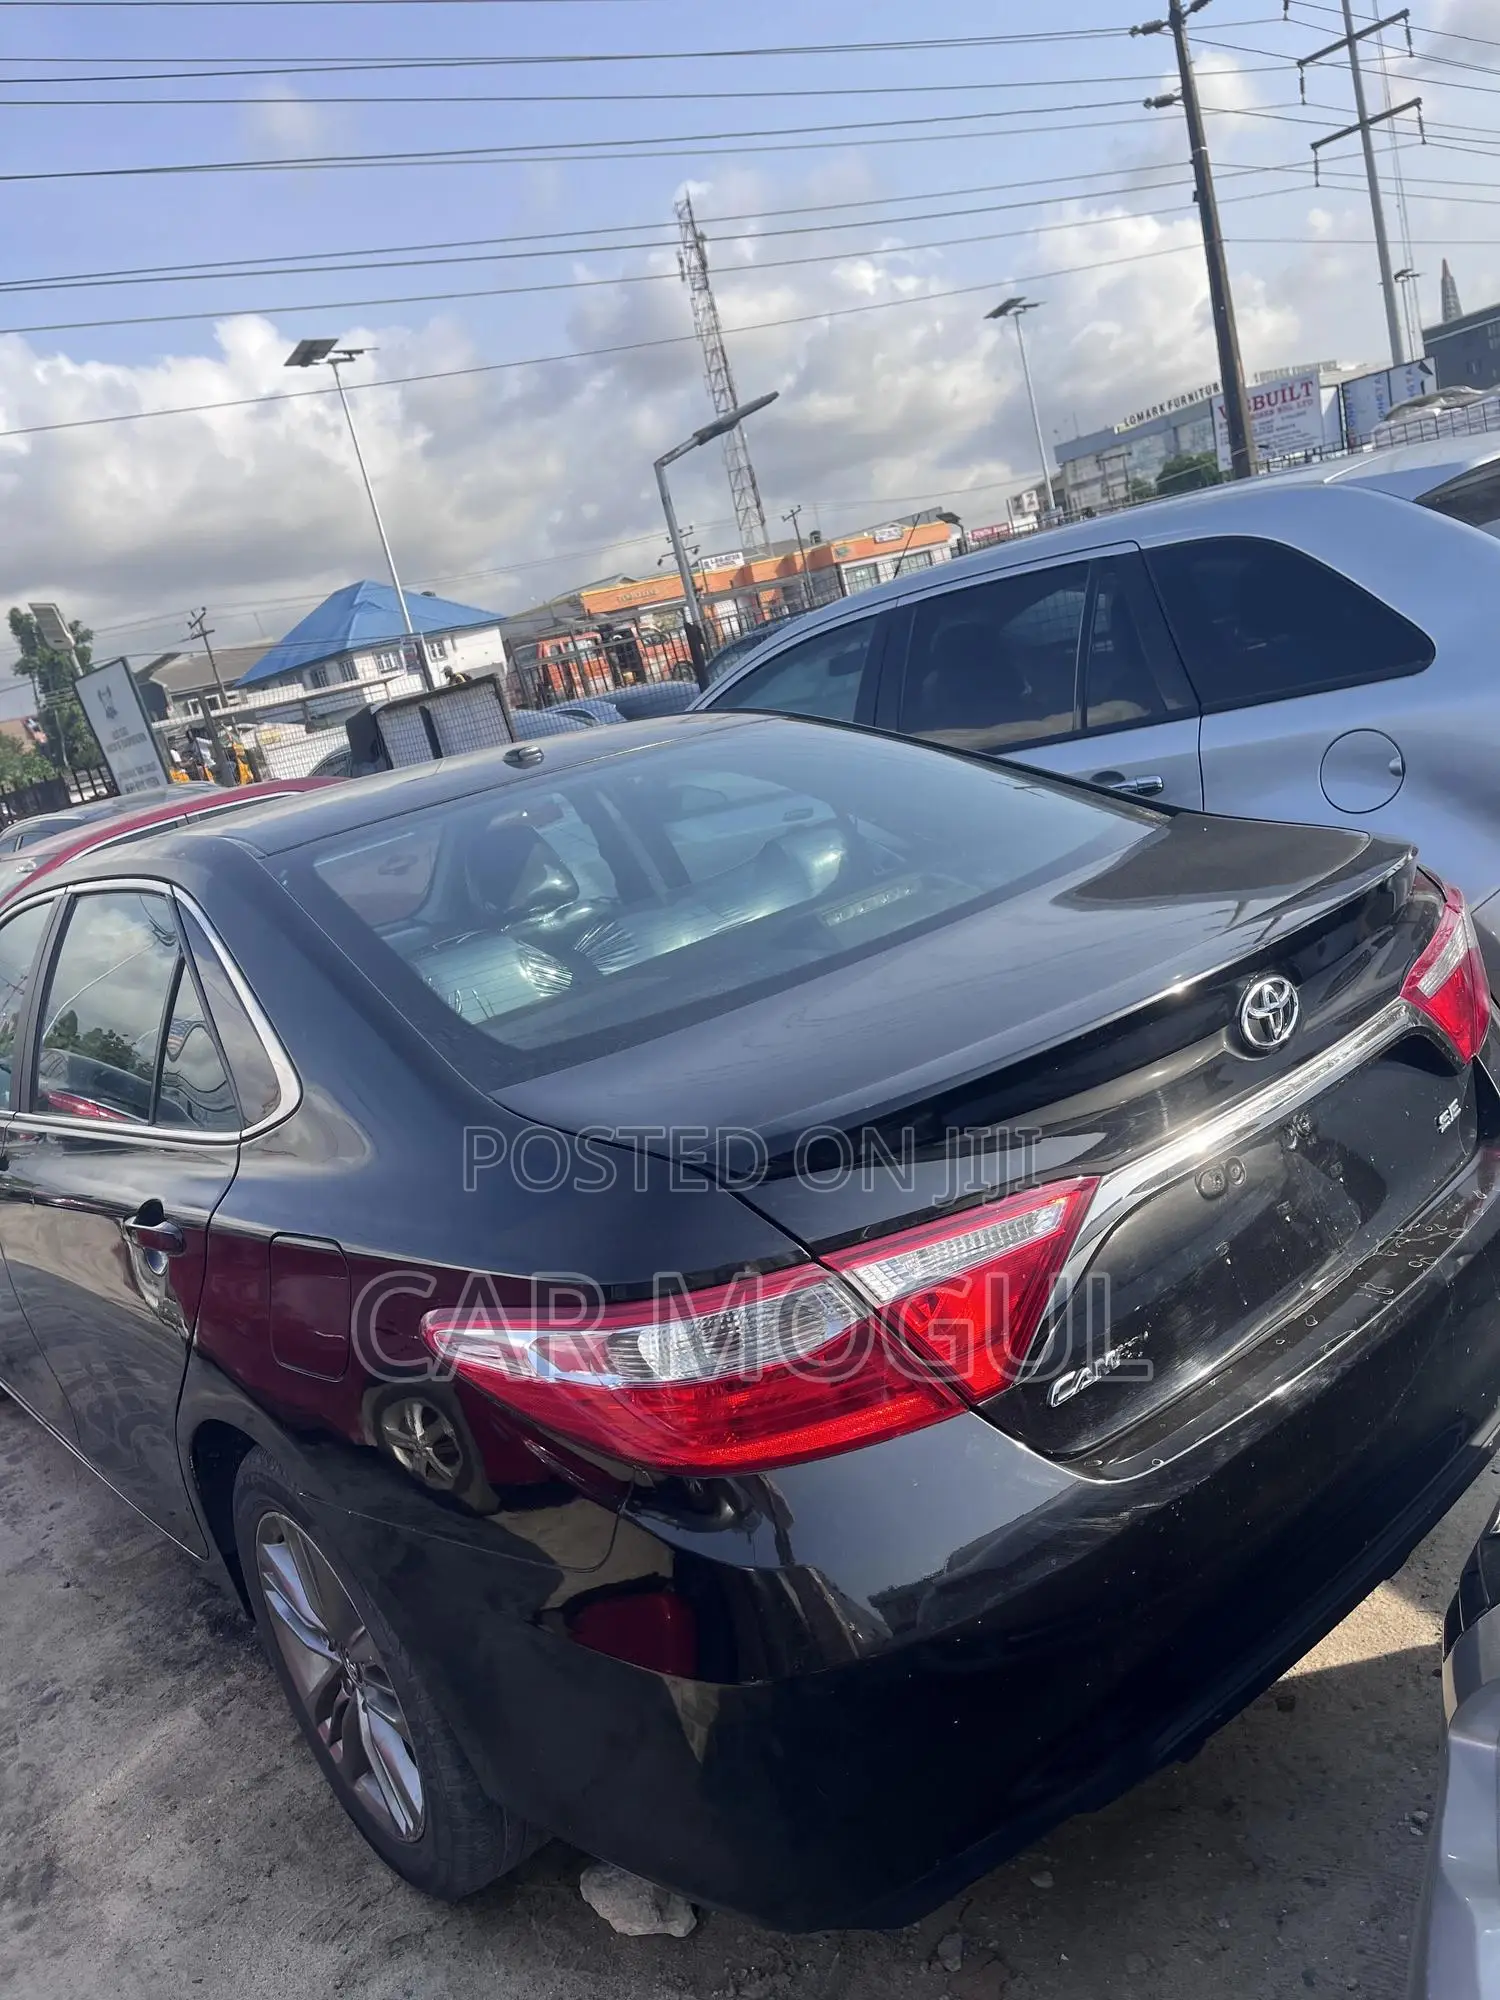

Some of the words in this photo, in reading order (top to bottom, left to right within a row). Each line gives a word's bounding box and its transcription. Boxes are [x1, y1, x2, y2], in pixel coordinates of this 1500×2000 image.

[1167, 382, 1220, 410] FURNITUR
[1219, 381, 1313, 419] BUILT
[1438, 1098, 1461, 1133] SE
[1047, 1330, 1149, 1408] CAM
